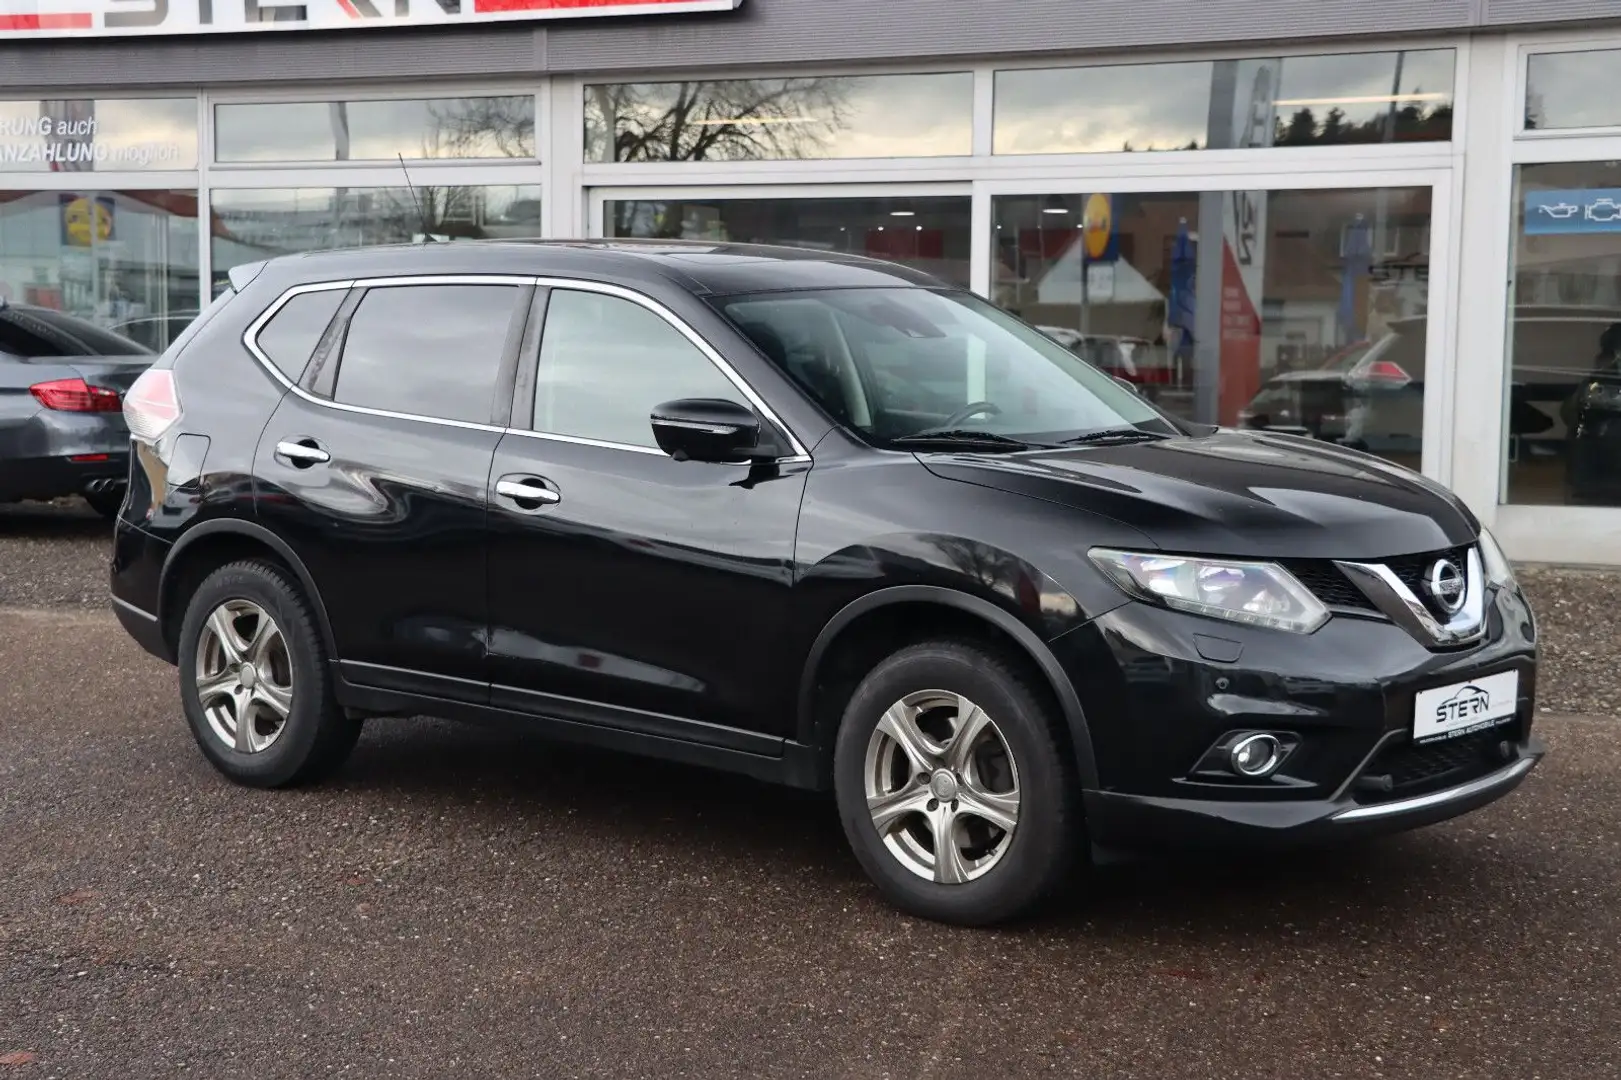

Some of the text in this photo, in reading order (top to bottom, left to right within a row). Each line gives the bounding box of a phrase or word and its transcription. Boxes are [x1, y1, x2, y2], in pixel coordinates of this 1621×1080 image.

[57, 116, 97, 136] auch
[0, 142, 108, 162] NZAHLUNG
[1436, 696, 1489, 723] STERN
